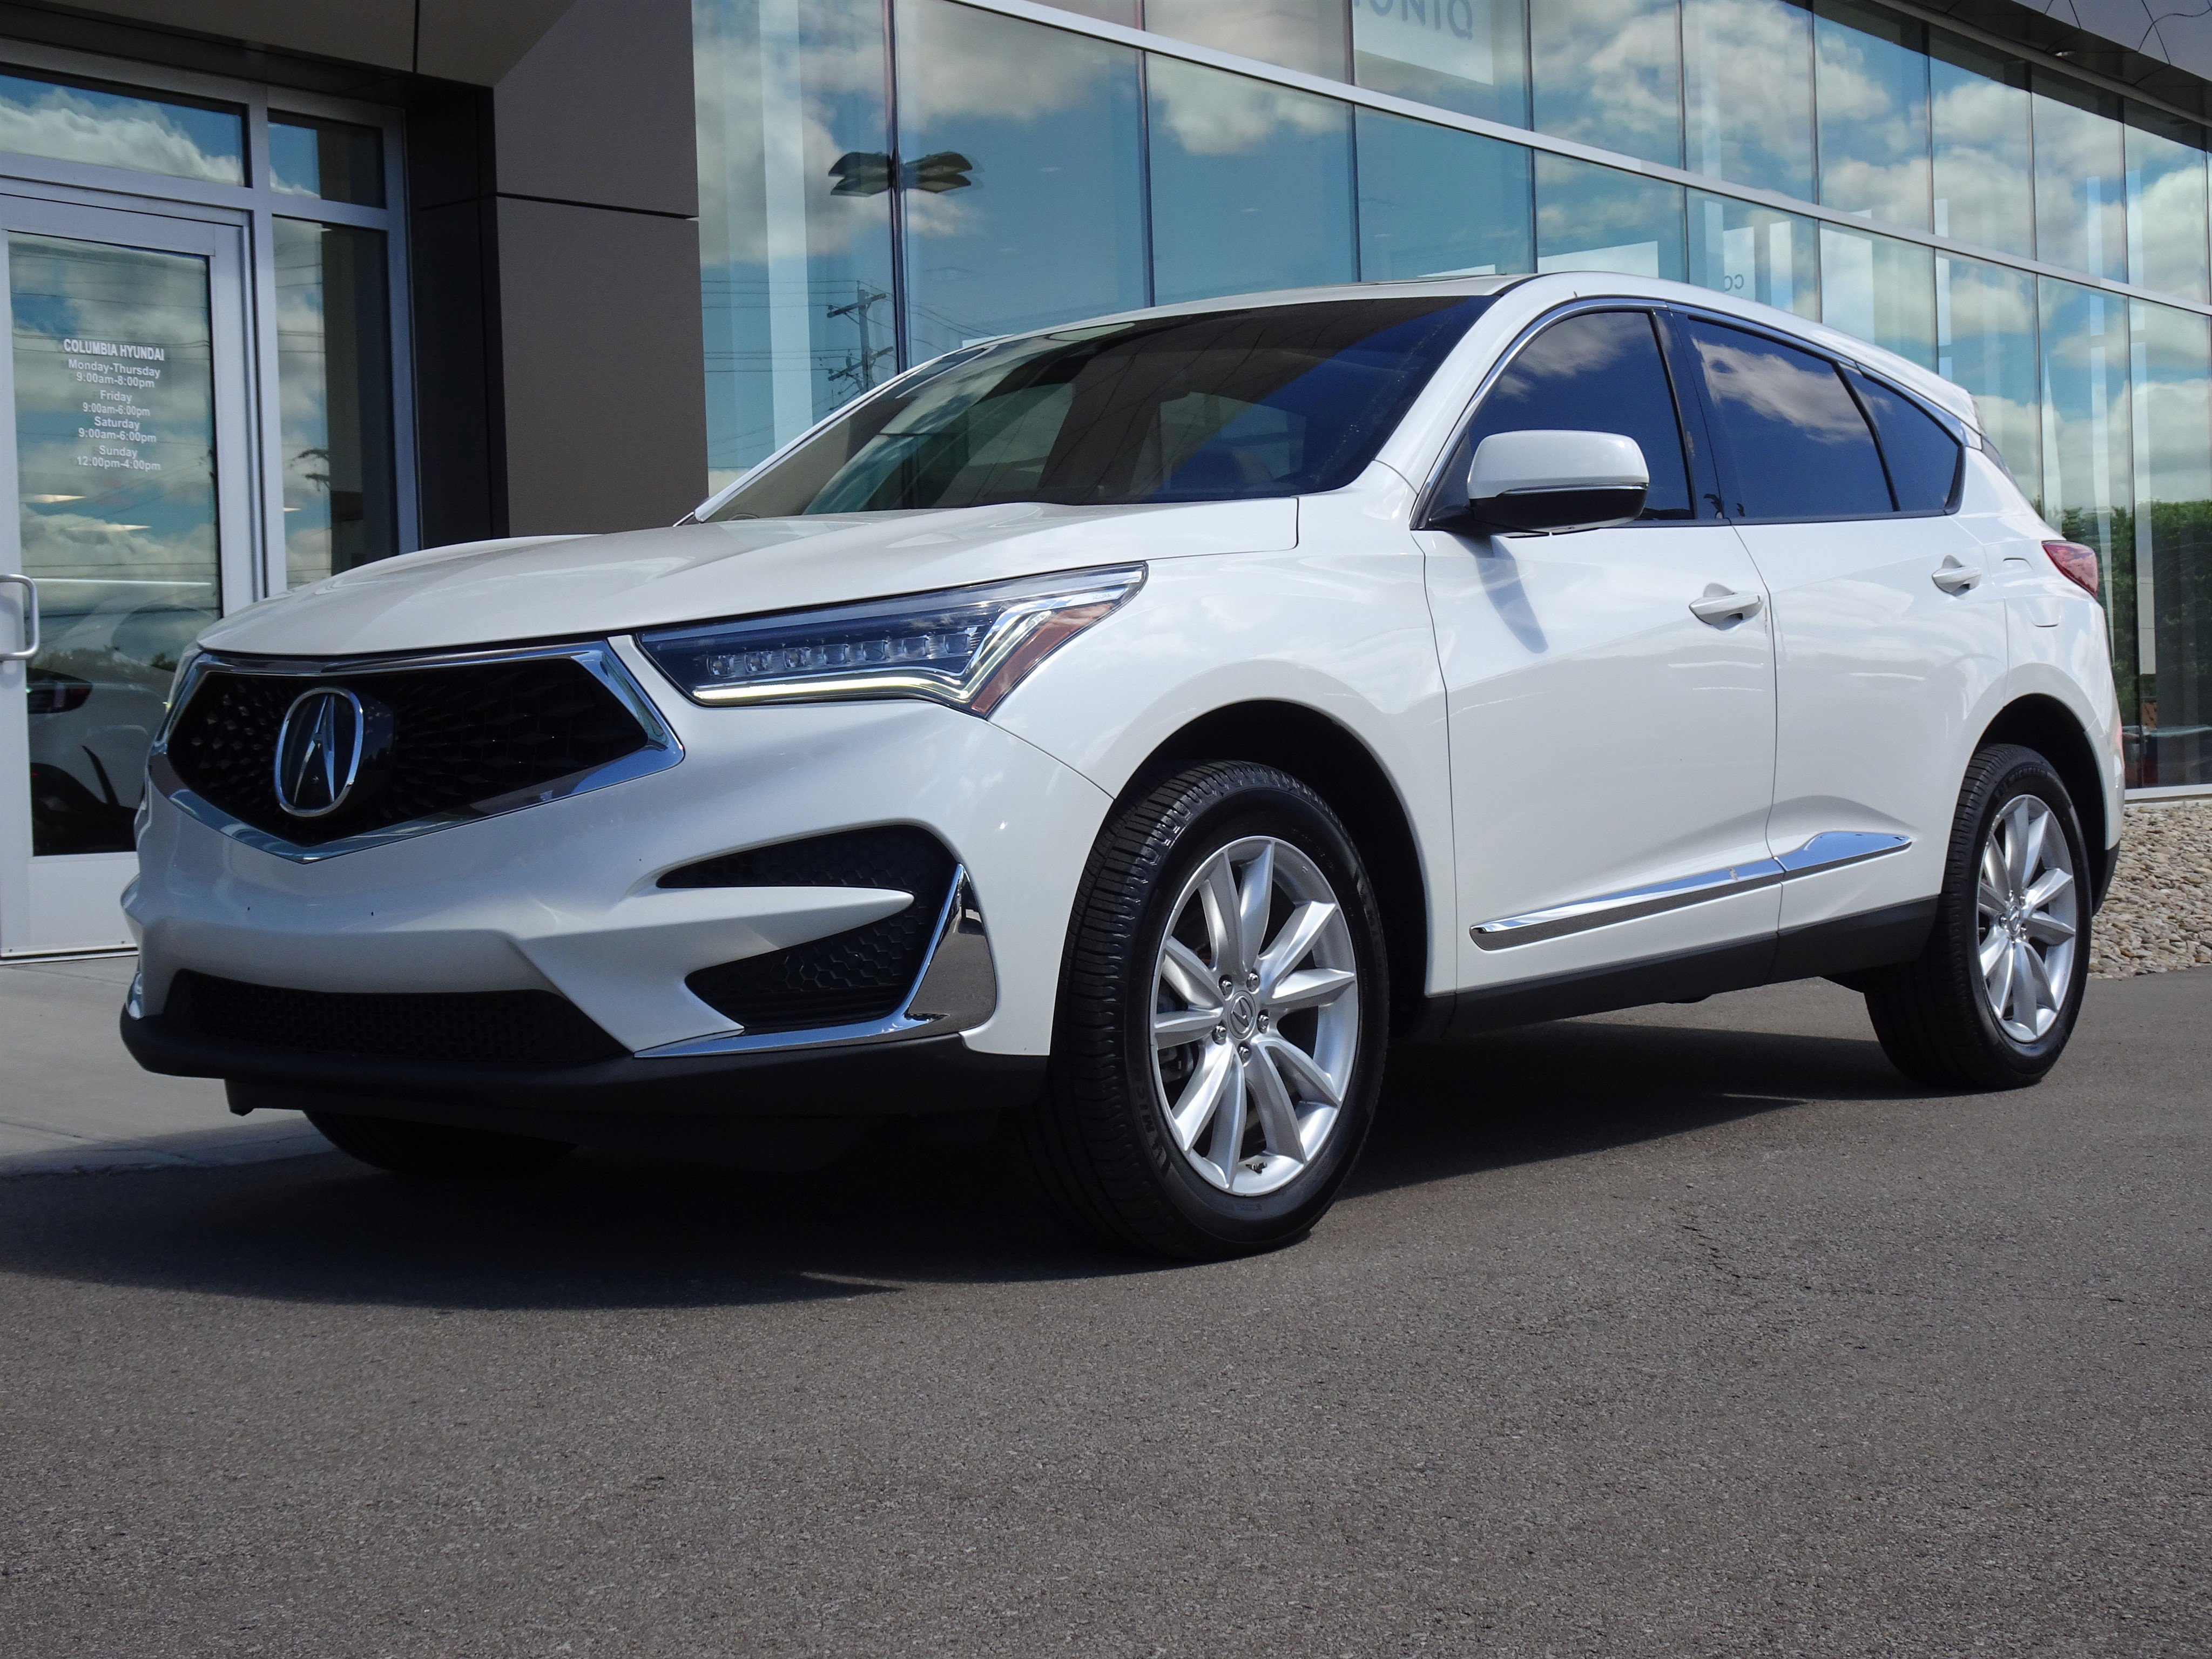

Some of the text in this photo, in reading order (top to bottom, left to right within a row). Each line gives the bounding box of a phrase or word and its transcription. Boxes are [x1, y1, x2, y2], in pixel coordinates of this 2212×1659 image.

[63, 339, 165, 361] COLUMBIA HYUNDAI
[68, 359, 160, 379] Monday-Thursday
[76, 372, 155, 389] 9:00am-8:00pm
[100, 390, 132, 403] Friday
[83, 402, 150, 418] 9:00am-6:00pm
[94, 416, 140, 431] Saturday
[78, 428, 156, 443] 9:00am-6:00pm
[99, 445, 138, 458] Sunday
[77, 456, 160, 471] 12:00pm-4:00pm
